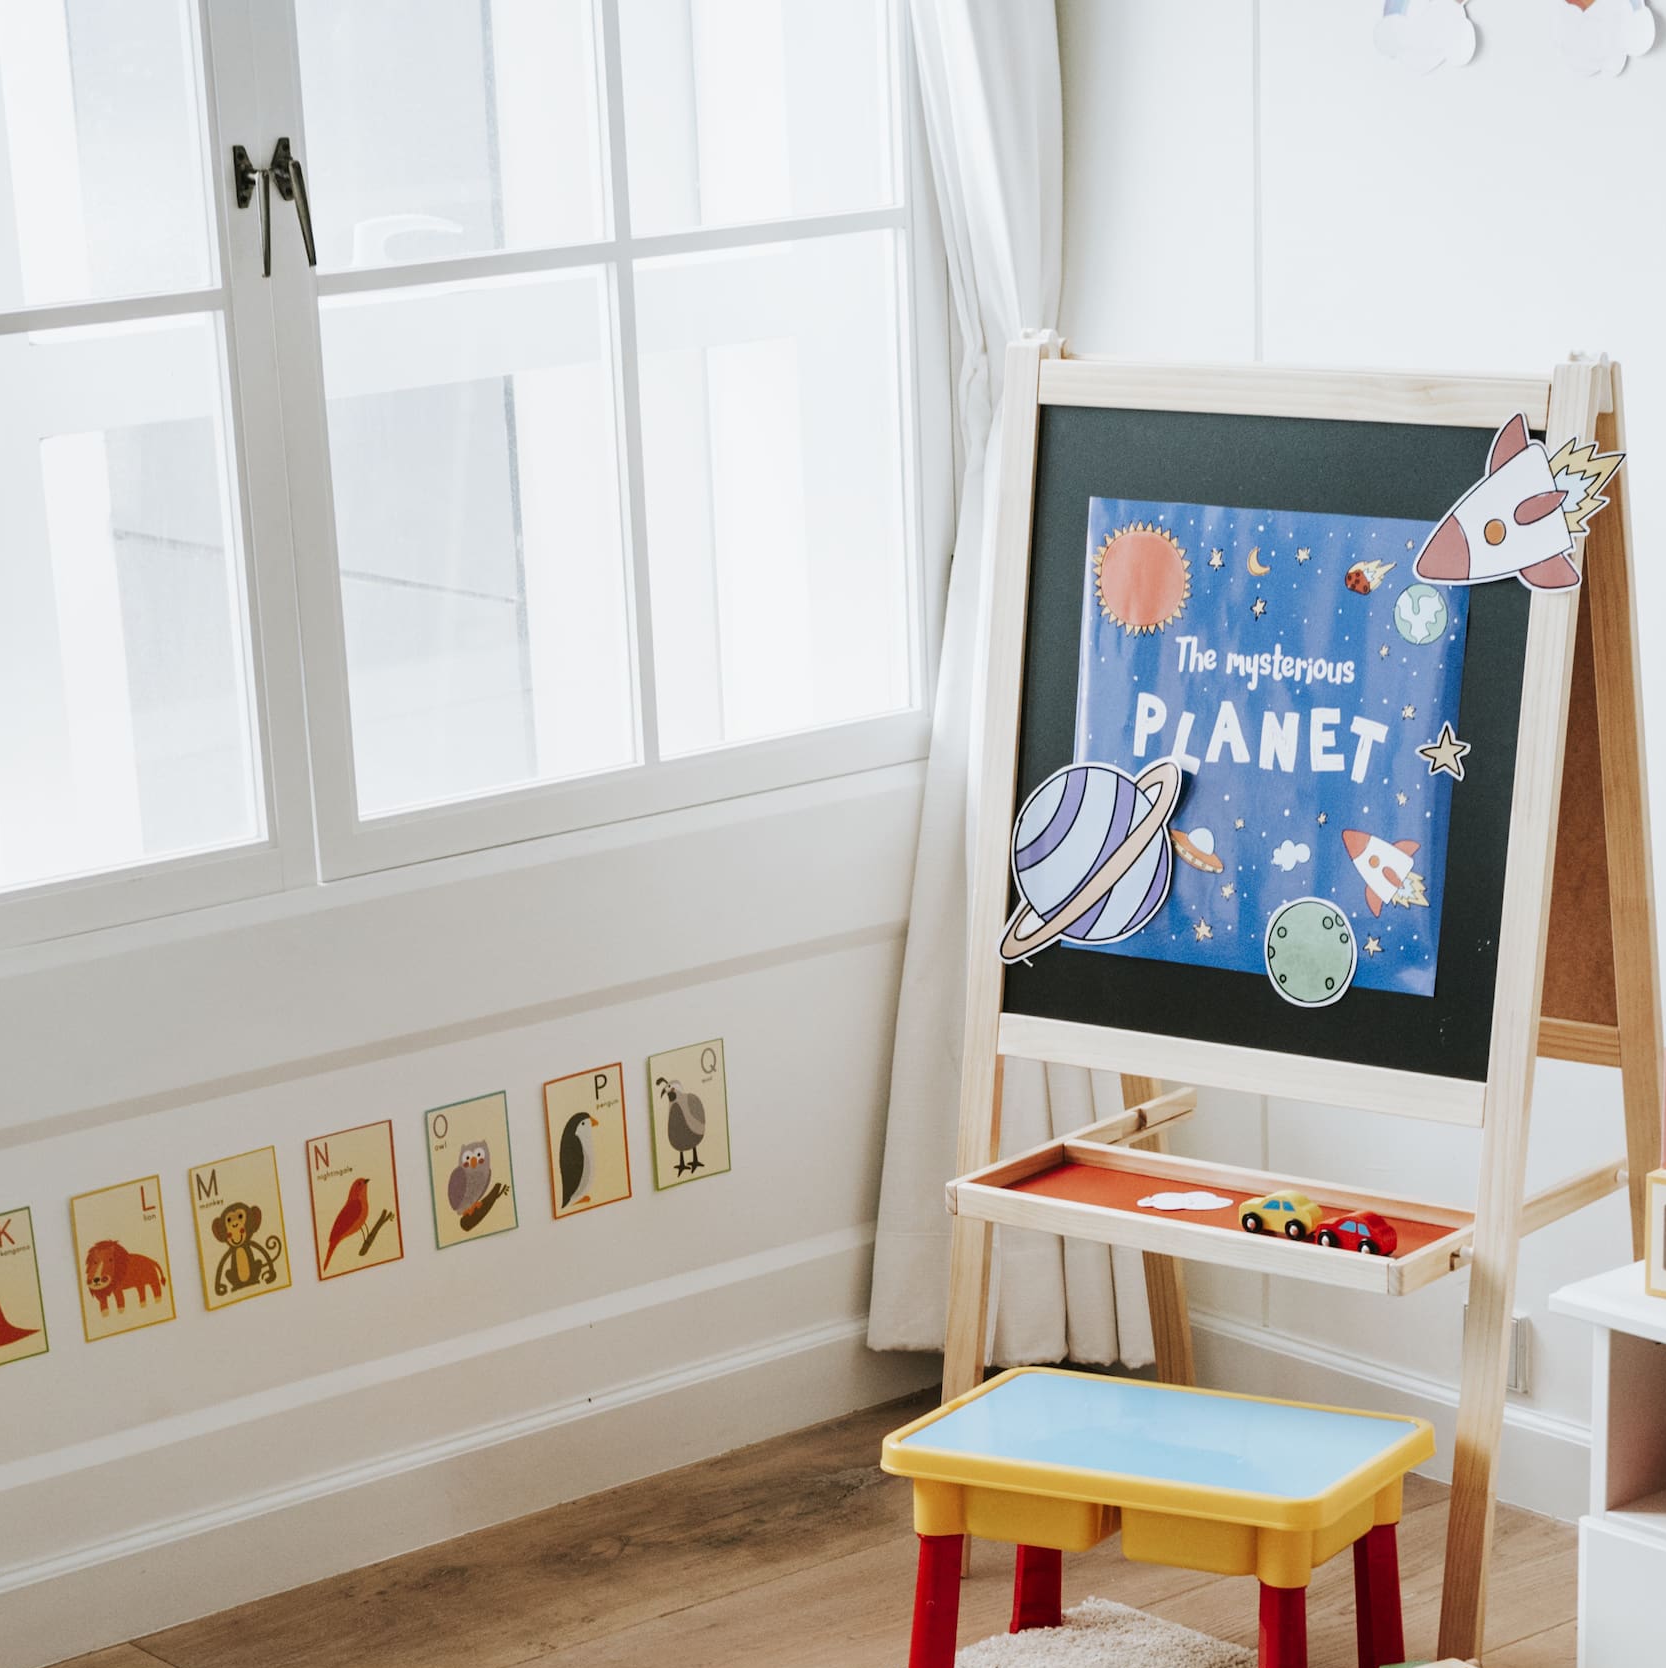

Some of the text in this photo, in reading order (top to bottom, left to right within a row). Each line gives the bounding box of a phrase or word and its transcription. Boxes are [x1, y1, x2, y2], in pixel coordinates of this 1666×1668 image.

[1174, 635, 1356, 691] The mysterious
[1132, 691, 1389, 784] PLANET
[700, 1047, 717, 1074] Q
[594, 1073, 608, 1100] P
[313, 1142, 330, 1171] N
[140, 1185, 157, 1212] L
[195, 1168, 219, 1201] M
[143, 1213, 157, 1223] lion
